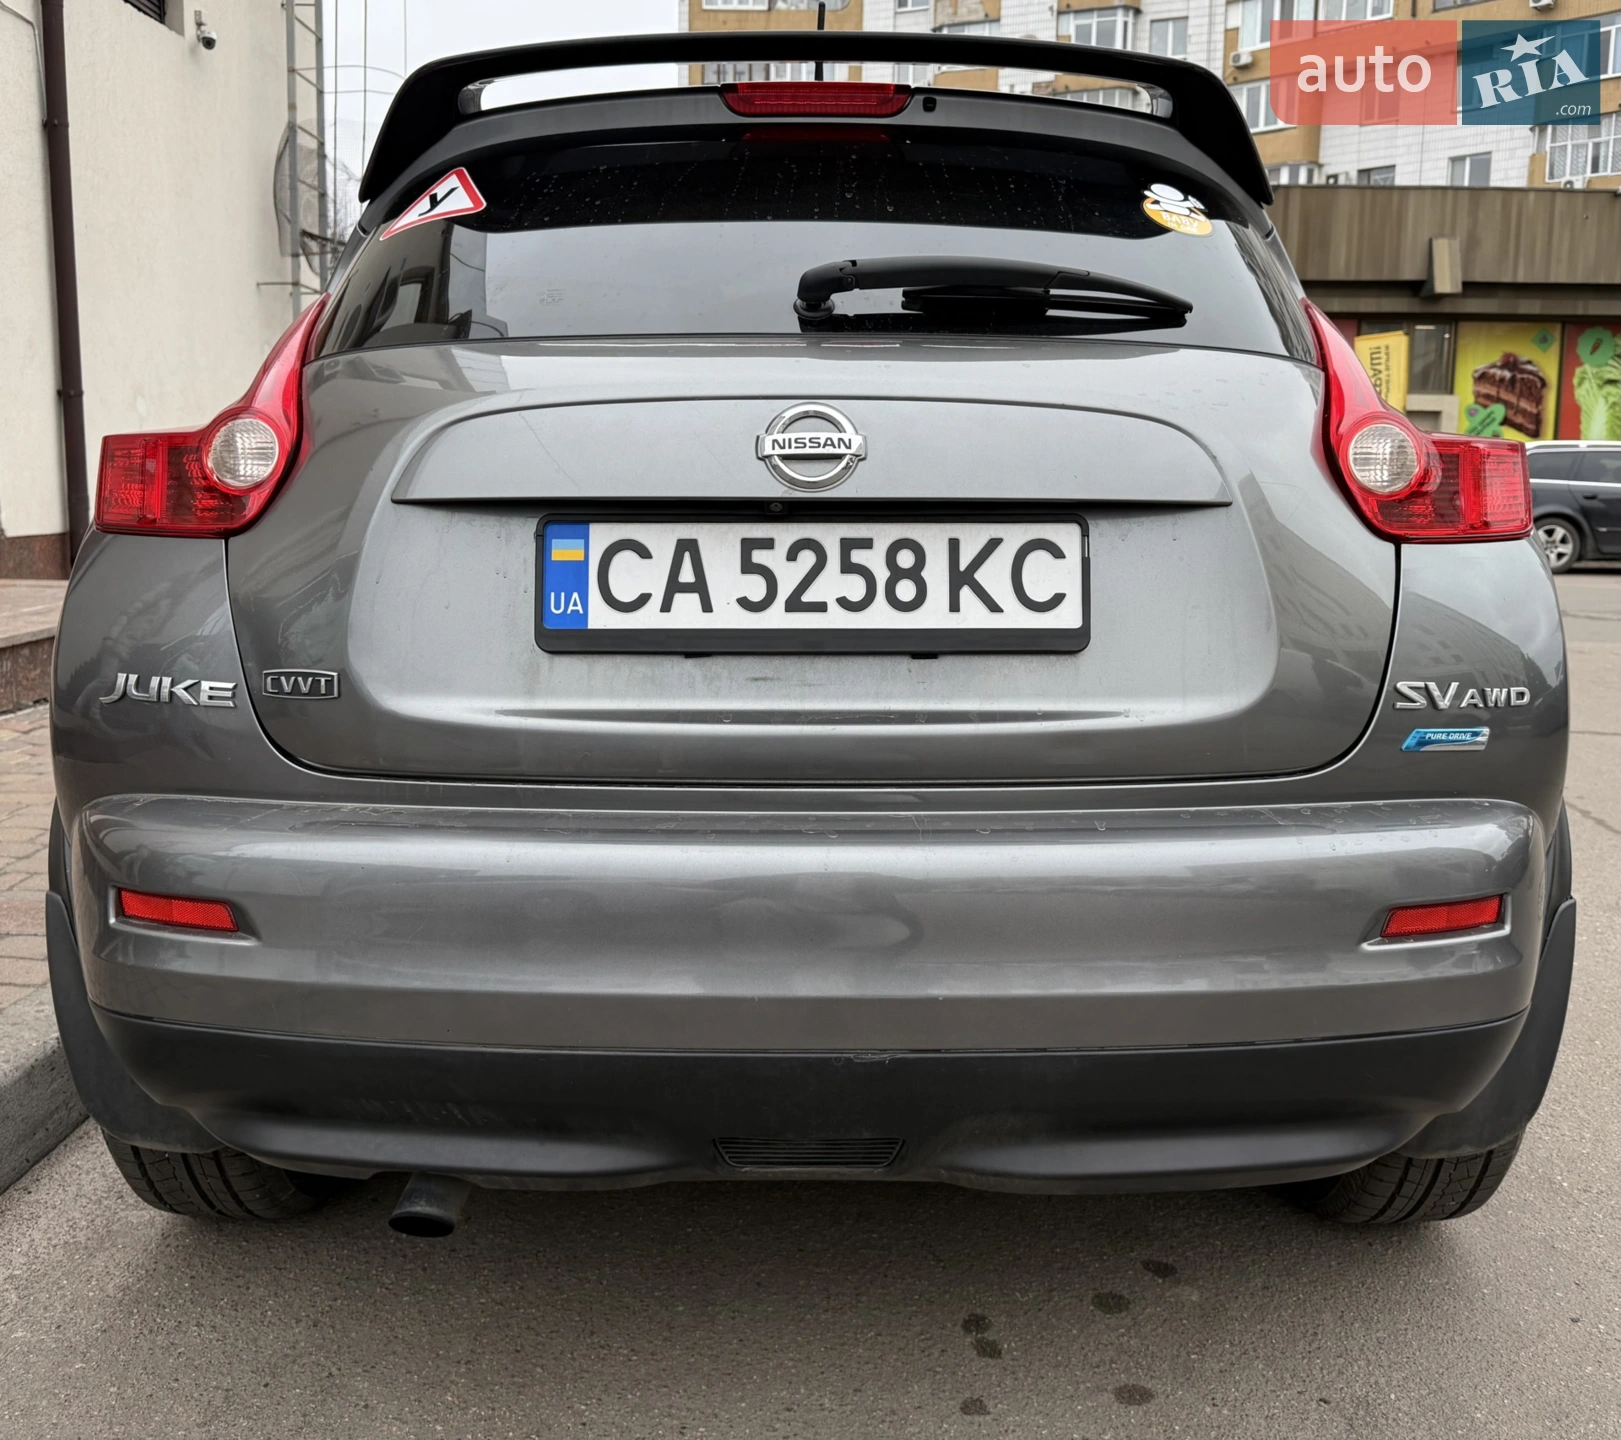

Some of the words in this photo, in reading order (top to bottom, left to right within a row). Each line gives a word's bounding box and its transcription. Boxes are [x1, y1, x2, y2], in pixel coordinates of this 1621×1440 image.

[1160, 211, 1200, 229] BABY
[771, 436, 852, 451] NISSAN
[597, 538, 714, 614] CA
[736, 538, 928, 614] 5258
[948, 538, 1067, 614] KC
[550, 591, 584, 614] UA
[99, 672, 238, 708] JUKE
[266, 675, 332, 695] CVVT
[1394, 681, 1460, 710] SV
[1459, 687, 1531, 708] AWD
[1425, 732, 1448, 740] PURE
[1448, 732, 1473, 740] DRIVE
